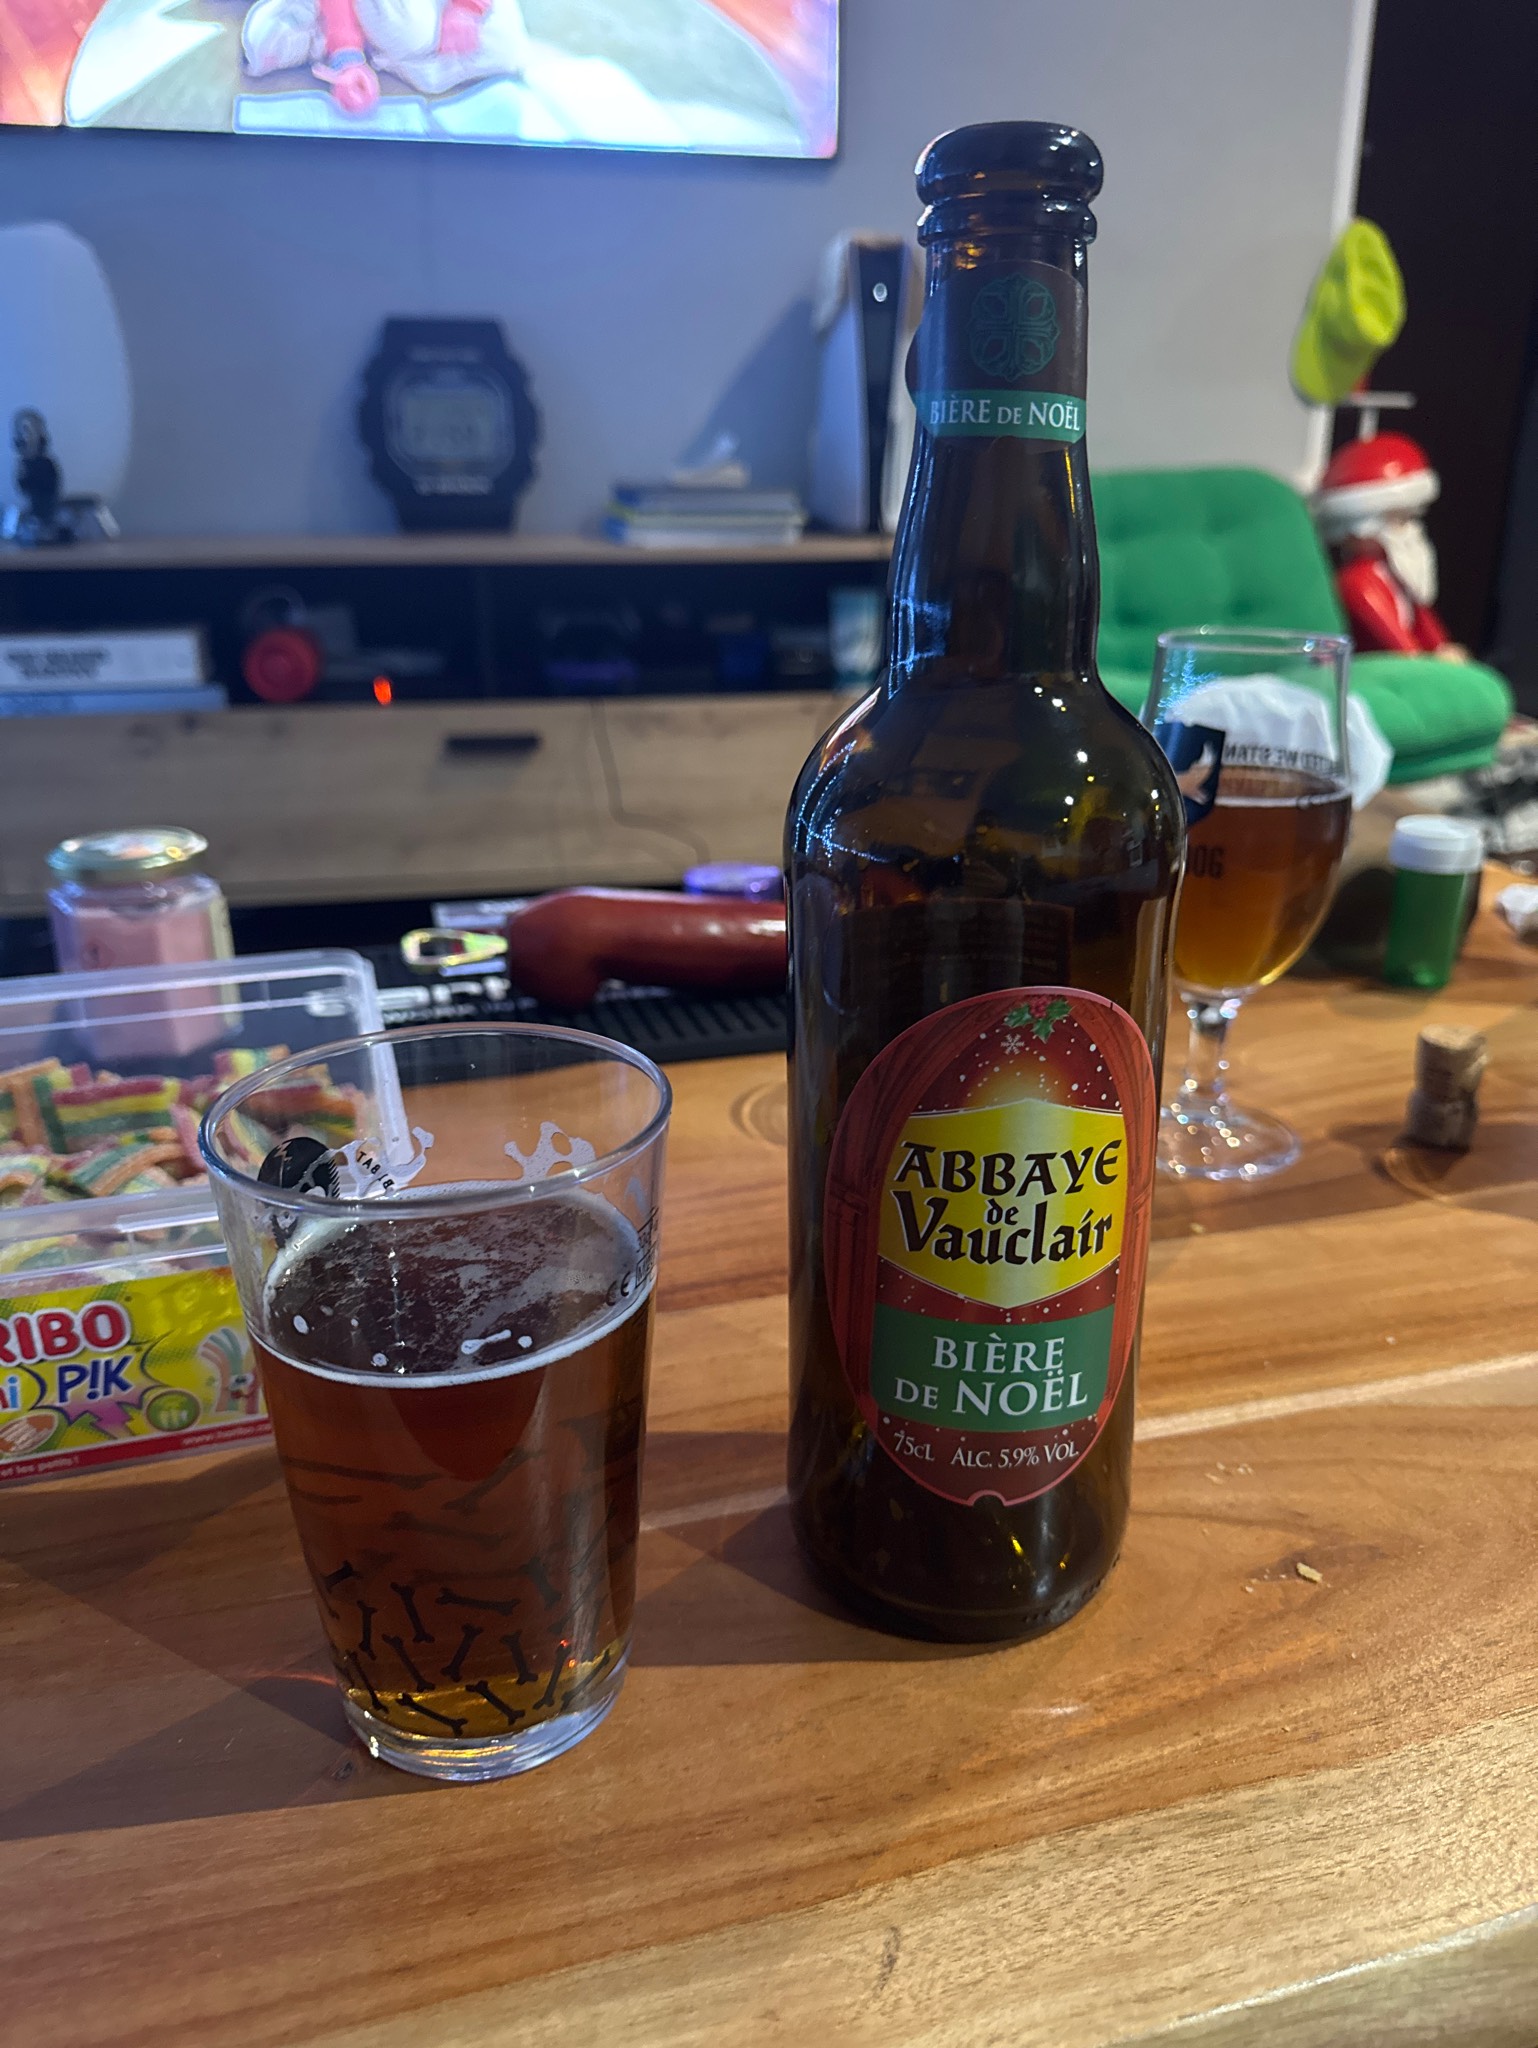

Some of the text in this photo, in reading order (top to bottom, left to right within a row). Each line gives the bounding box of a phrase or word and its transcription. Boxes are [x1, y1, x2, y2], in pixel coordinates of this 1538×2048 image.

[929, 394, 991, 424] BIÈRE
[1028, 401, 1081, 431] NOËL
[893, 1139, 1122, 1197] ABBAYE
[890, 1191, 1112, 1265] Vauclair
[986, 1198, 1019, 1226] de
[931, 1332, 1065, 1374] BIÈRE
[894, 1368, 1087, 1416] DE NOËL
[998, 1446, 1039, 1469] 5,9%
